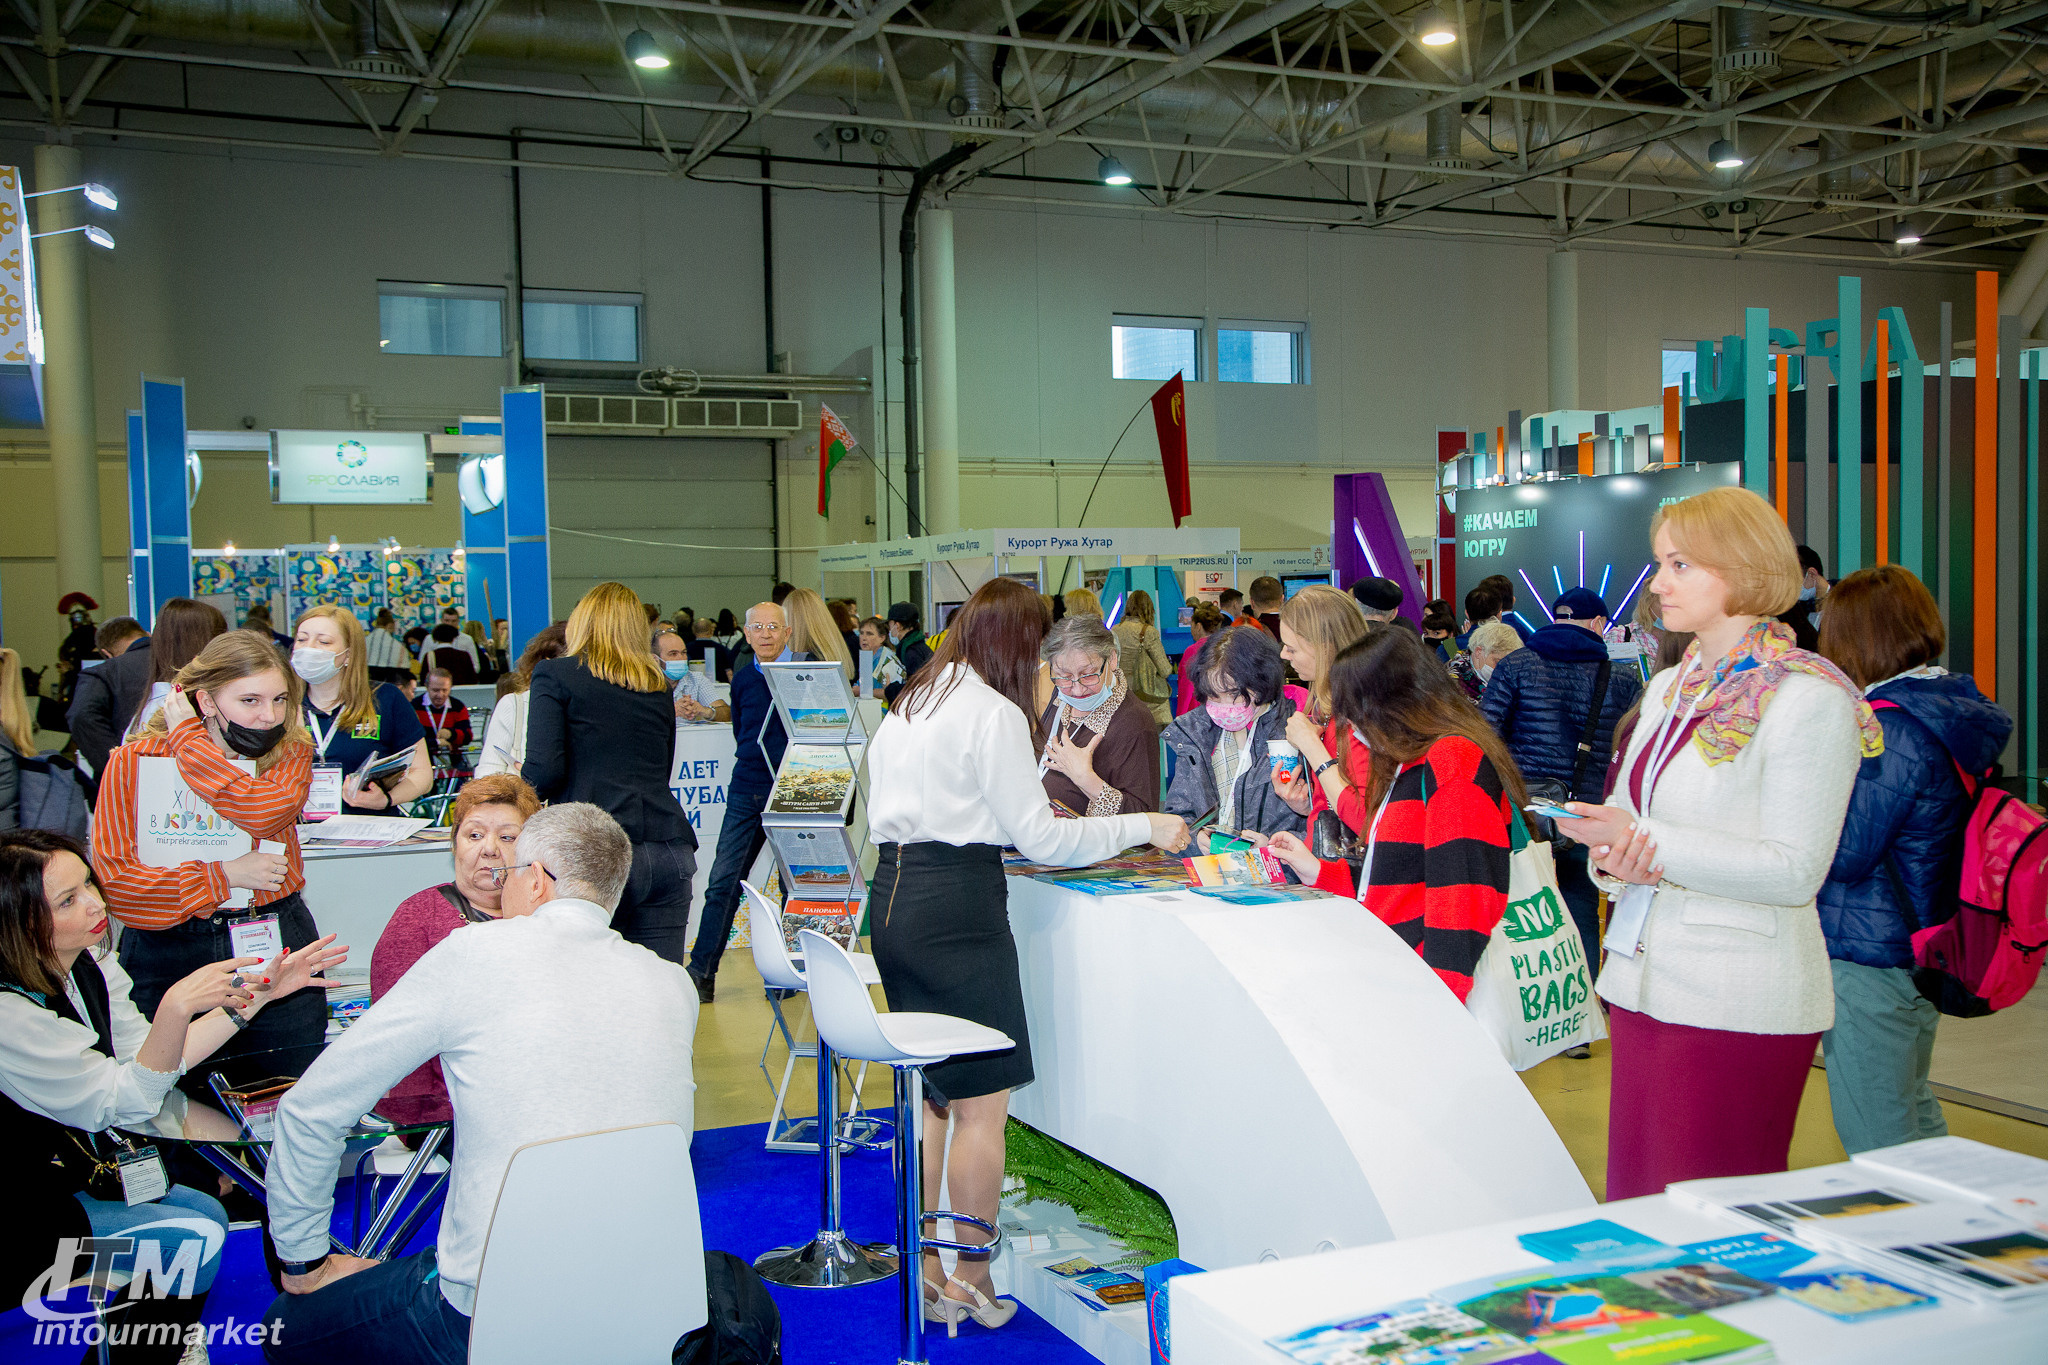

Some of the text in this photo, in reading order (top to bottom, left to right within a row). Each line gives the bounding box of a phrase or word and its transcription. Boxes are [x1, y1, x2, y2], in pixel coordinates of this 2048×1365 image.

[307, 474, 399, 486] ЯРОСЛАВИЯ
[1464, 508, 1538, 532] #КАЧАЕМ
[1007, 536, 1113, 549] Курорт Ружа Хутар
[1464, 537, 1507, 558] ЮГРУ
[1179, 557, 1228, 565] TRIP2RUS.RU
[678, 760, 719, 779] ЛЕТ
[670, 785, 727, 805] ПУБЛ
[151, 810, 234, 831] В КРЫМ
[157, 837, 228, 846] mirprekrasen.com
[1514, 896, 1554, 933] NO
[1519, 965, 1588, 1023] BAGS
